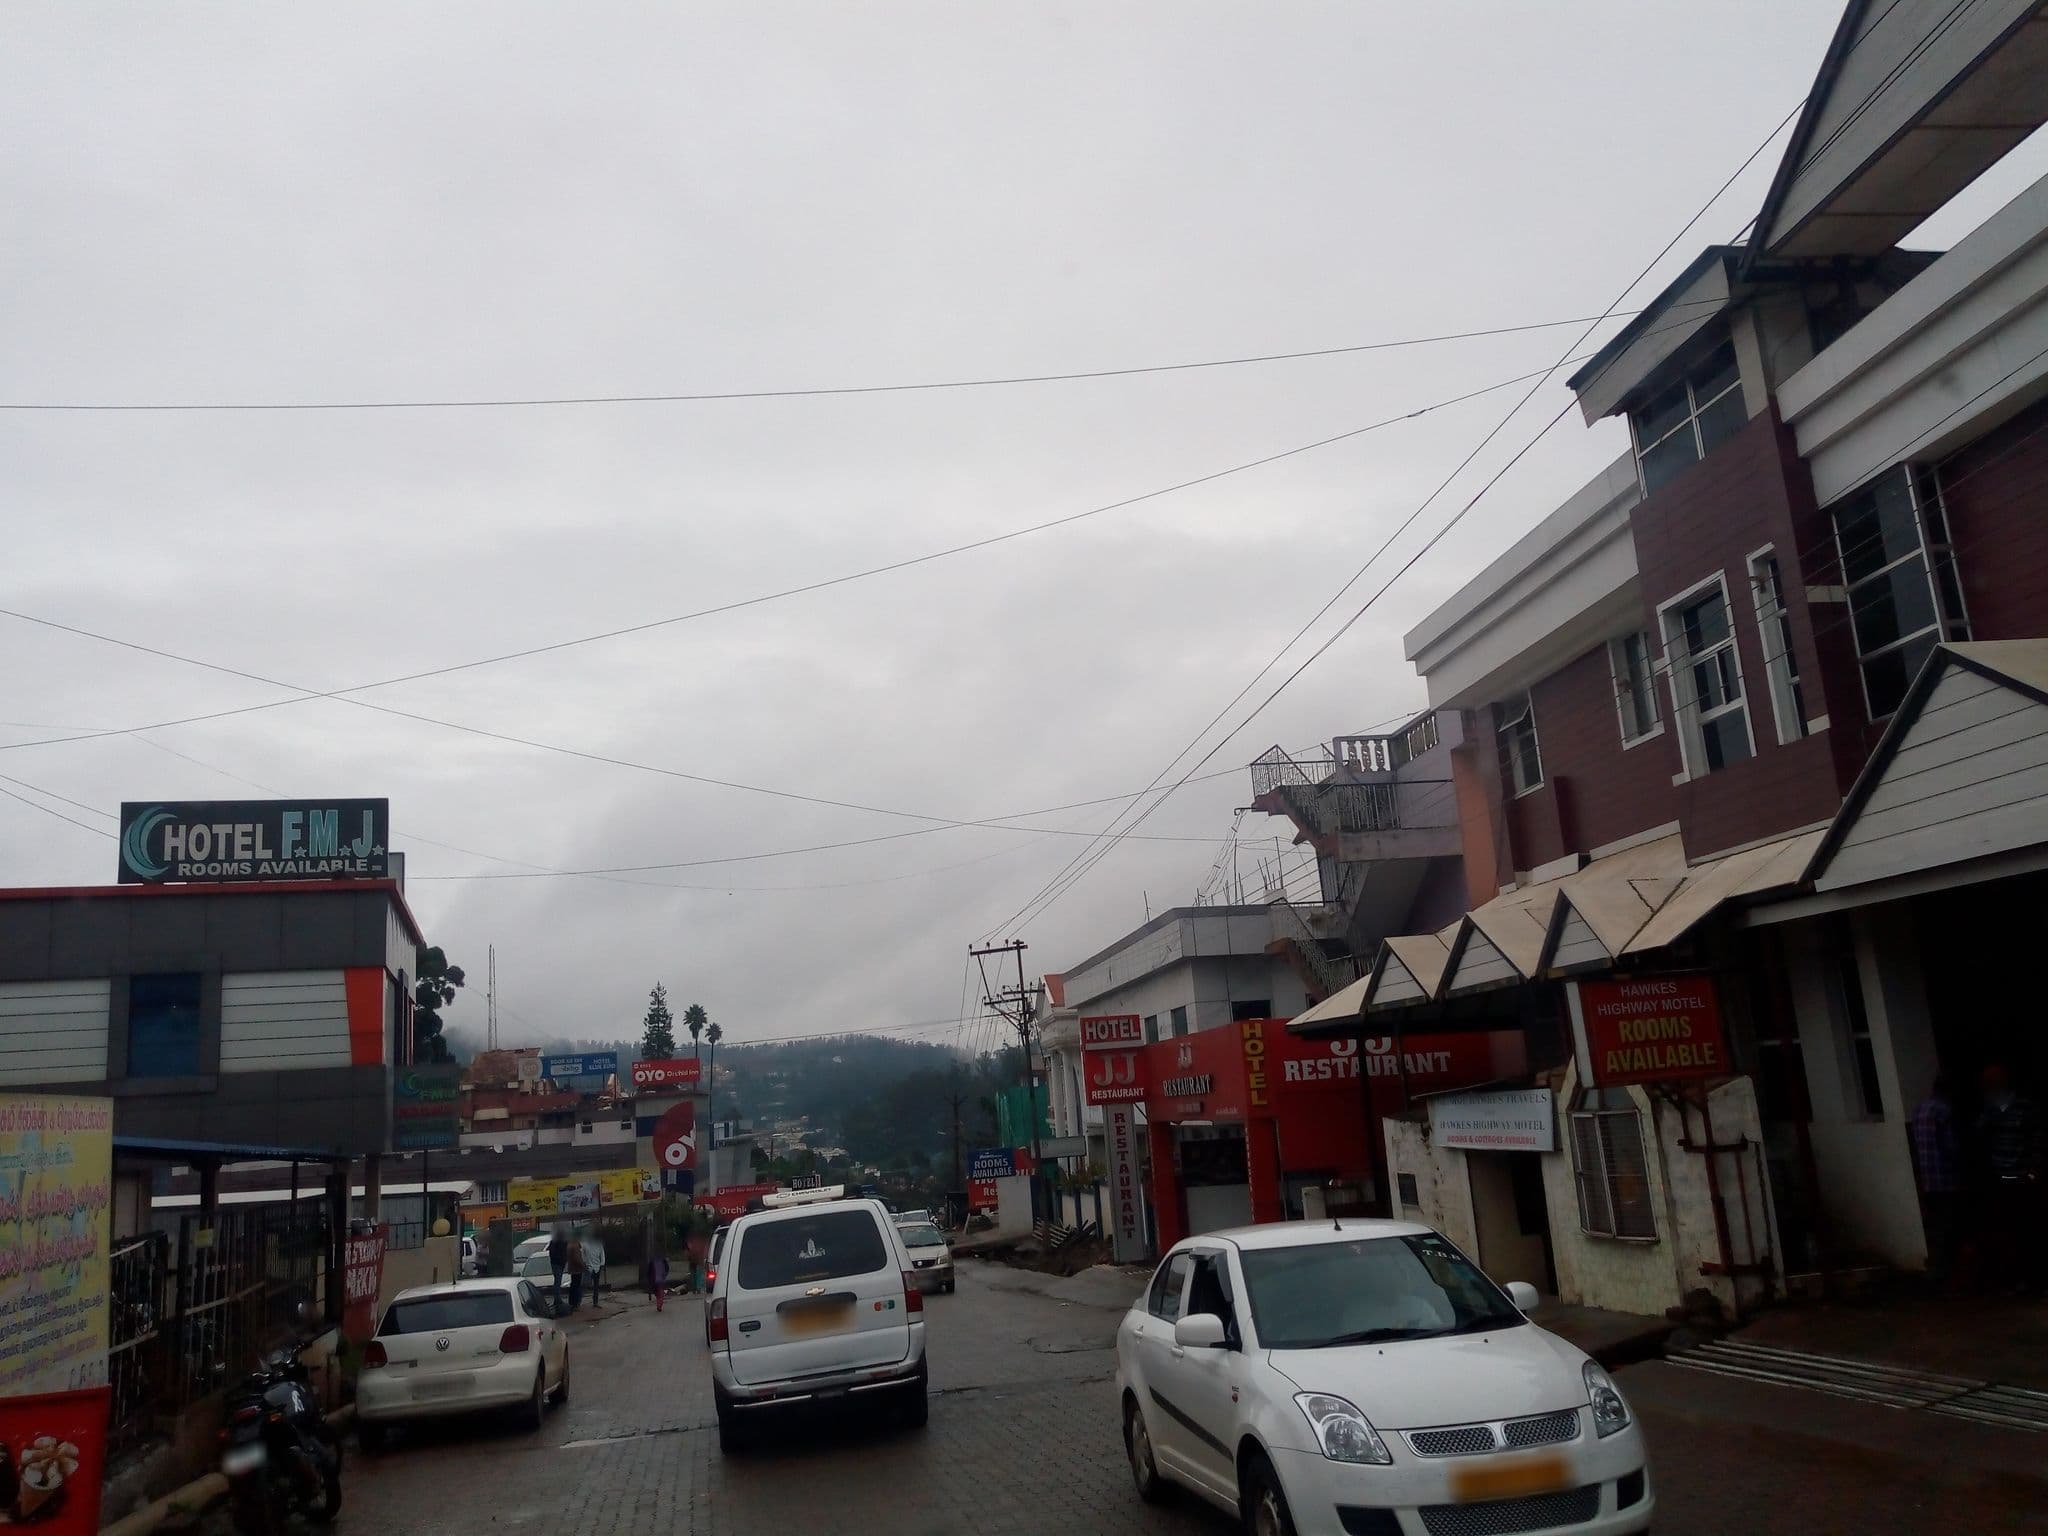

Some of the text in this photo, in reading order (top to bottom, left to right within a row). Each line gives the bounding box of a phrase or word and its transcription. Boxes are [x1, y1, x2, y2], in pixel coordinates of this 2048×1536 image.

[164, 823, 273, 862] HOTEL
[178, 858, 368, 877] ROOMS AVAILABLE
[1620, 982, 1678, 998] HAWKES
[1598, 996, 1705, 1016] HIGHWAY MOTEL
[1085, 1018, 1140, 1040] HOTEL
[1618, 1015, 1692, 1043] ROOMS
[1242, 1022, 1267, 1105] HOTEL
[1284, 1051, 1451, 1082] RESTAURANT
[1607, 1042, 1718, 1073] AVAILABLE
[635, 1069, 666, 1082] OYO
[667, 1069, 688, 1077] Orchid
[1094, 1052, 1137, 1087] JJ
[1091, 1087, 1145, 1100] RESTAURANT
[1162, 1073, 1211, 1097] RESTAURANT
[1506, 1093, 1548, 1104] TRAVELS
[1440, 1119, 1545, 1131] HAWKES HIGHWAY MOTEL
[972, 1167, 1012, 1178] AVAILABLE
[974, 1158, 1009, 1169] ROOMS
[1114, 1112, 1136, 1239] RESTAURANT
